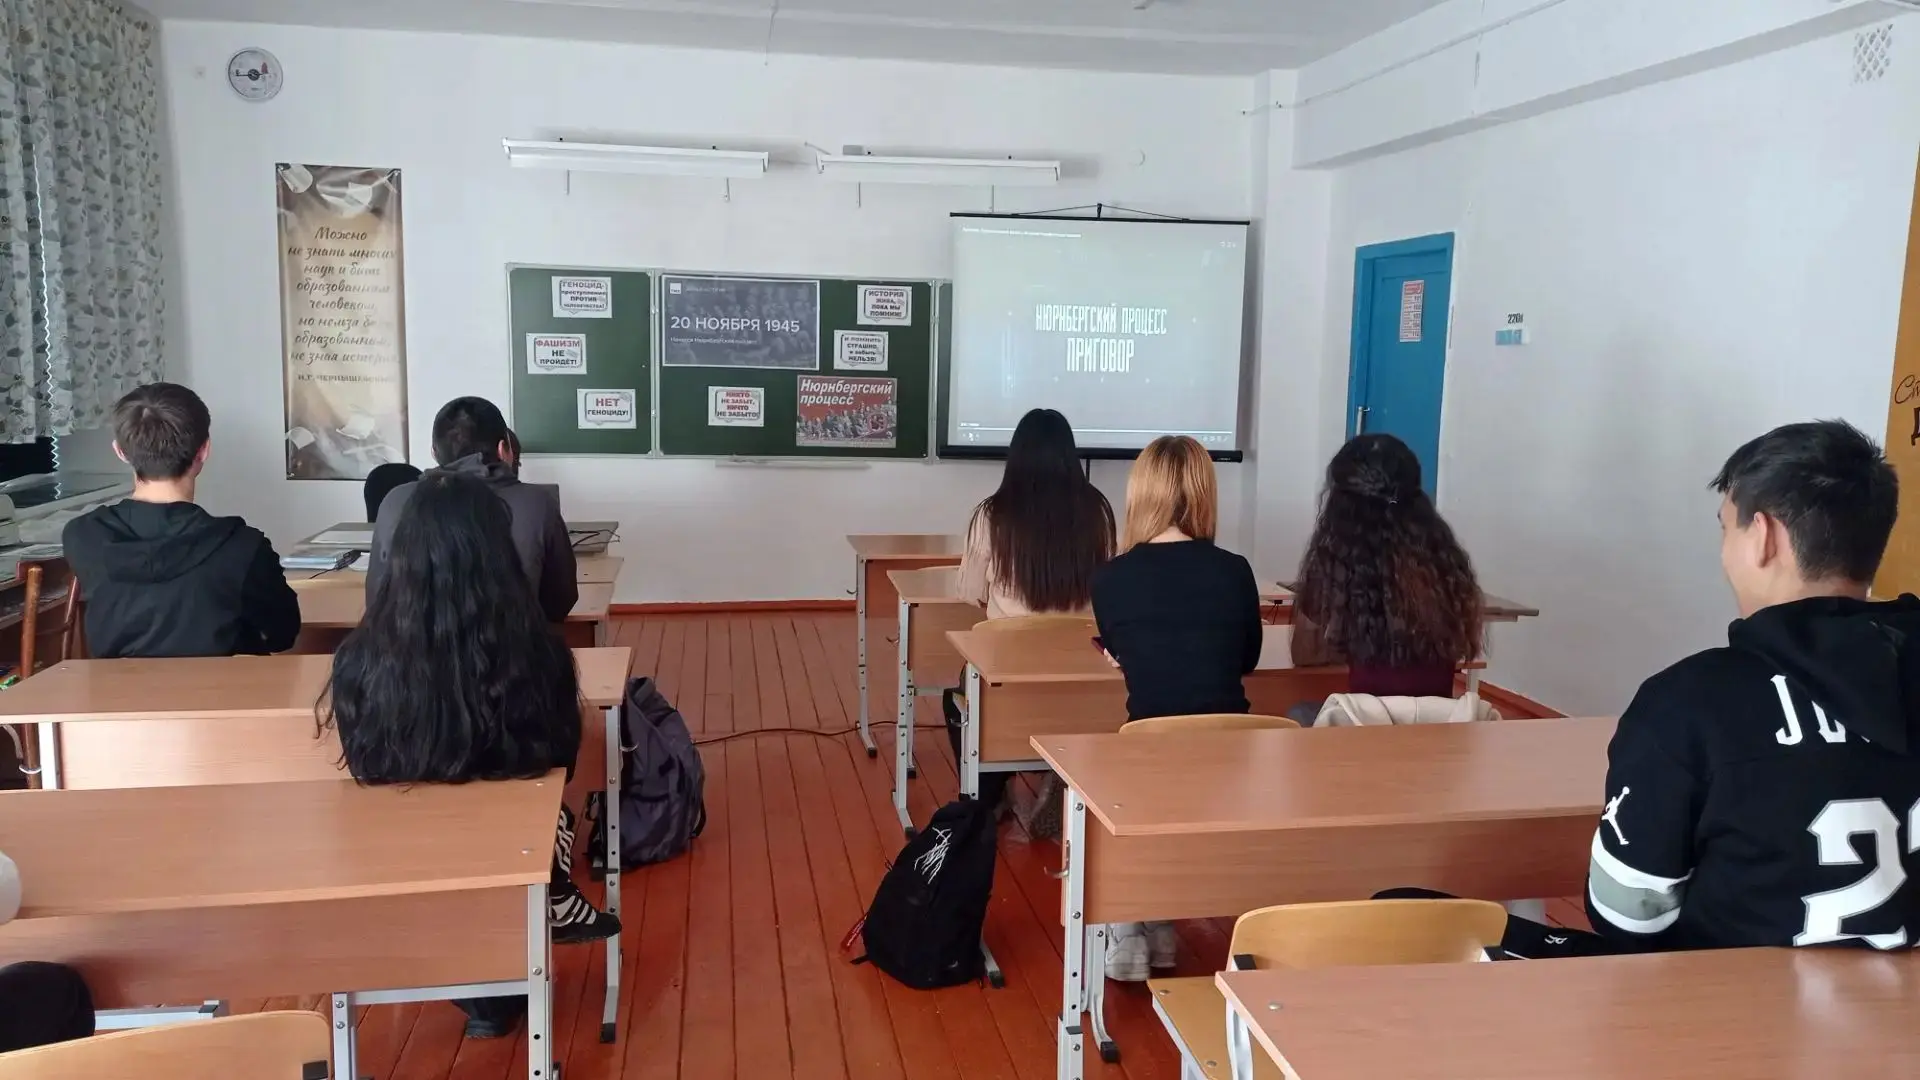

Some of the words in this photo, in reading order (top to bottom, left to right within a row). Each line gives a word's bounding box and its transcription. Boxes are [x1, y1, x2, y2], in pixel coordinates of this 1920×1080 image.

[314, 226, 368, 240] Можно
[306, 247, 346, 261] знать
[304, 264, 335, 278] наук
[338, 265, 346, 275] и
[868, 290, 904, 298] ИСТОРИЯ
[298, 317, 315, 326] но
[670, 316, 691, 329] 20
[695, 317, 760, 331] НОЯБРЯ
[765, 319, 800, 332] 1945
[1035, 303, 1117, 333] НЮРНБЕРГСКИЙ
[1121, 307, 1167, 336] ПРОЦЕСС
[536, 339, 580, 348] ФАШИЗМ
[290, 351, 305, 361] не
[307, 351, 338, 366] зная
[551, 349, 565, 357] НЕ
[1065, 337, 1135, 373] ПРИГОВОР
[800, 378, 893, 397] Нюрнбергский
[595, 398, 620, 407] НЕТ
[799, 394, 855, 407] процесс
[587, 409, 629, 417] ГЕНОЦИДУ!
[1792, 797, 1920, 951] 2
